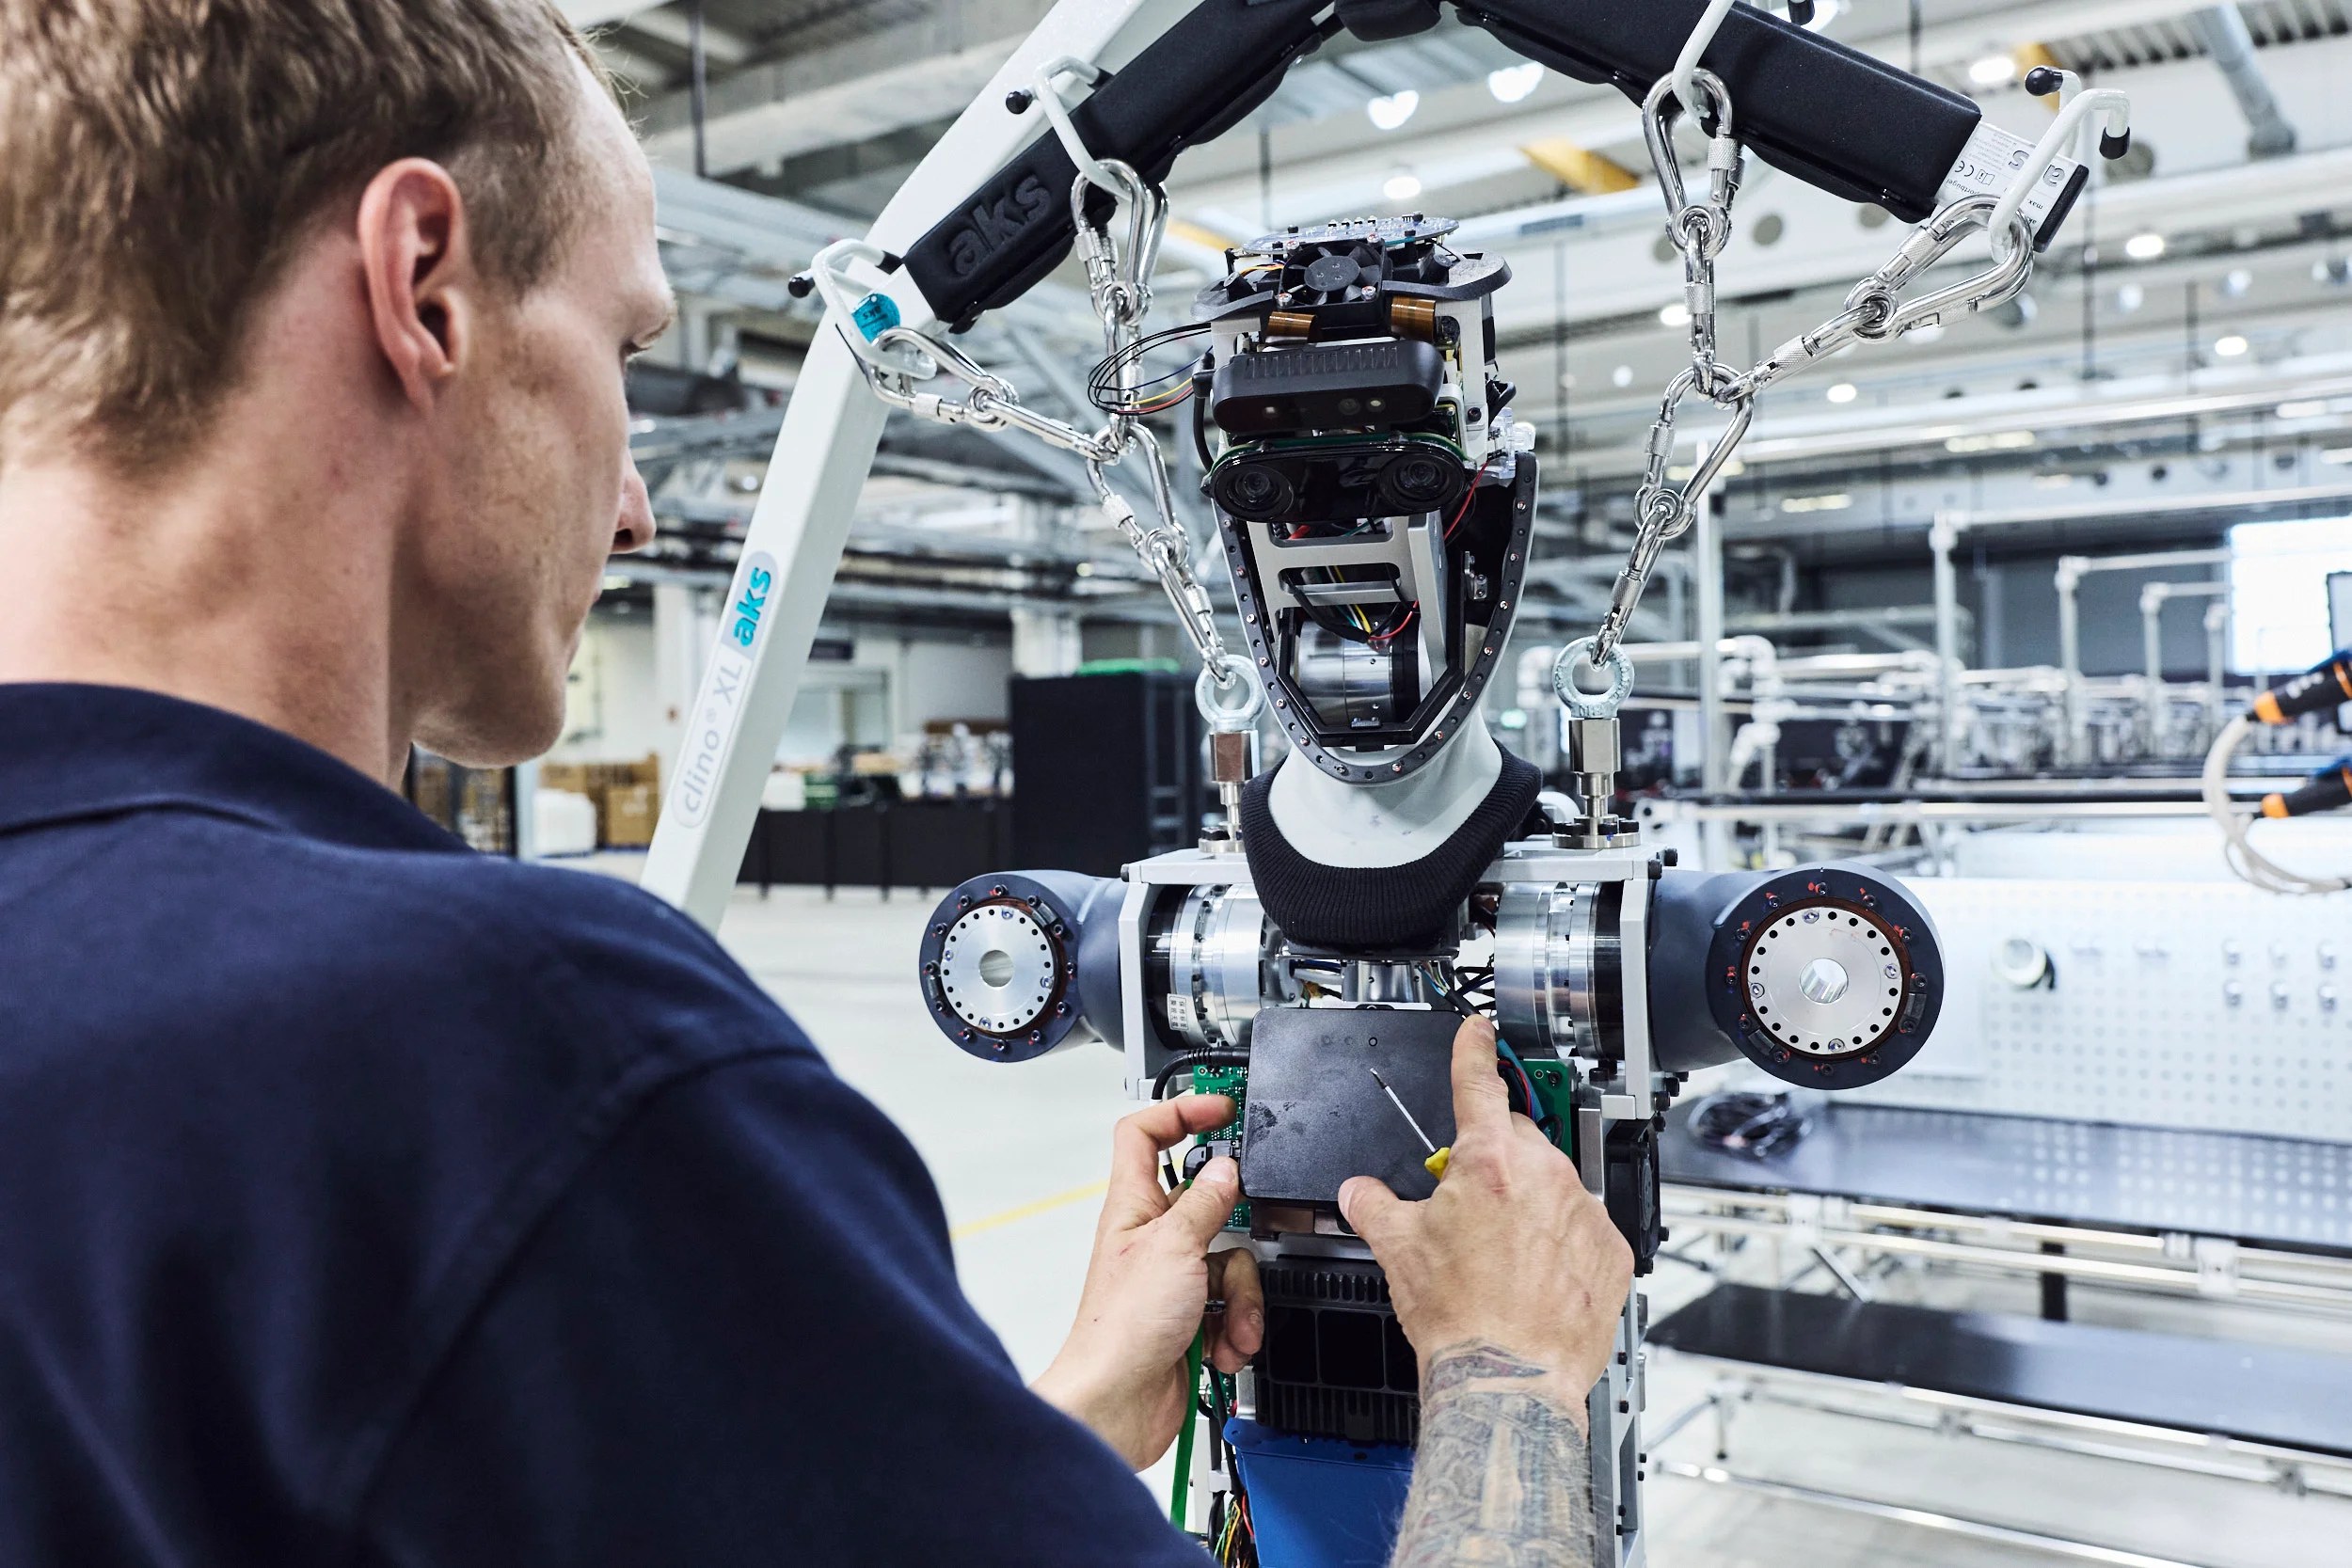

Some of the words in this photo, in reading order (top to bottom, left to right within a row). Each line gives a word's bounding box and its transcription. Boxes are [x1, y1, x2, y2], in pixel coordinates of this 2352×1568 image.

[2009, 150, 2066, 187] as
[948, 174, 1053, 276] aks
[733, 566, 771, 647] aks
[713, 663, 743, 706] XL
